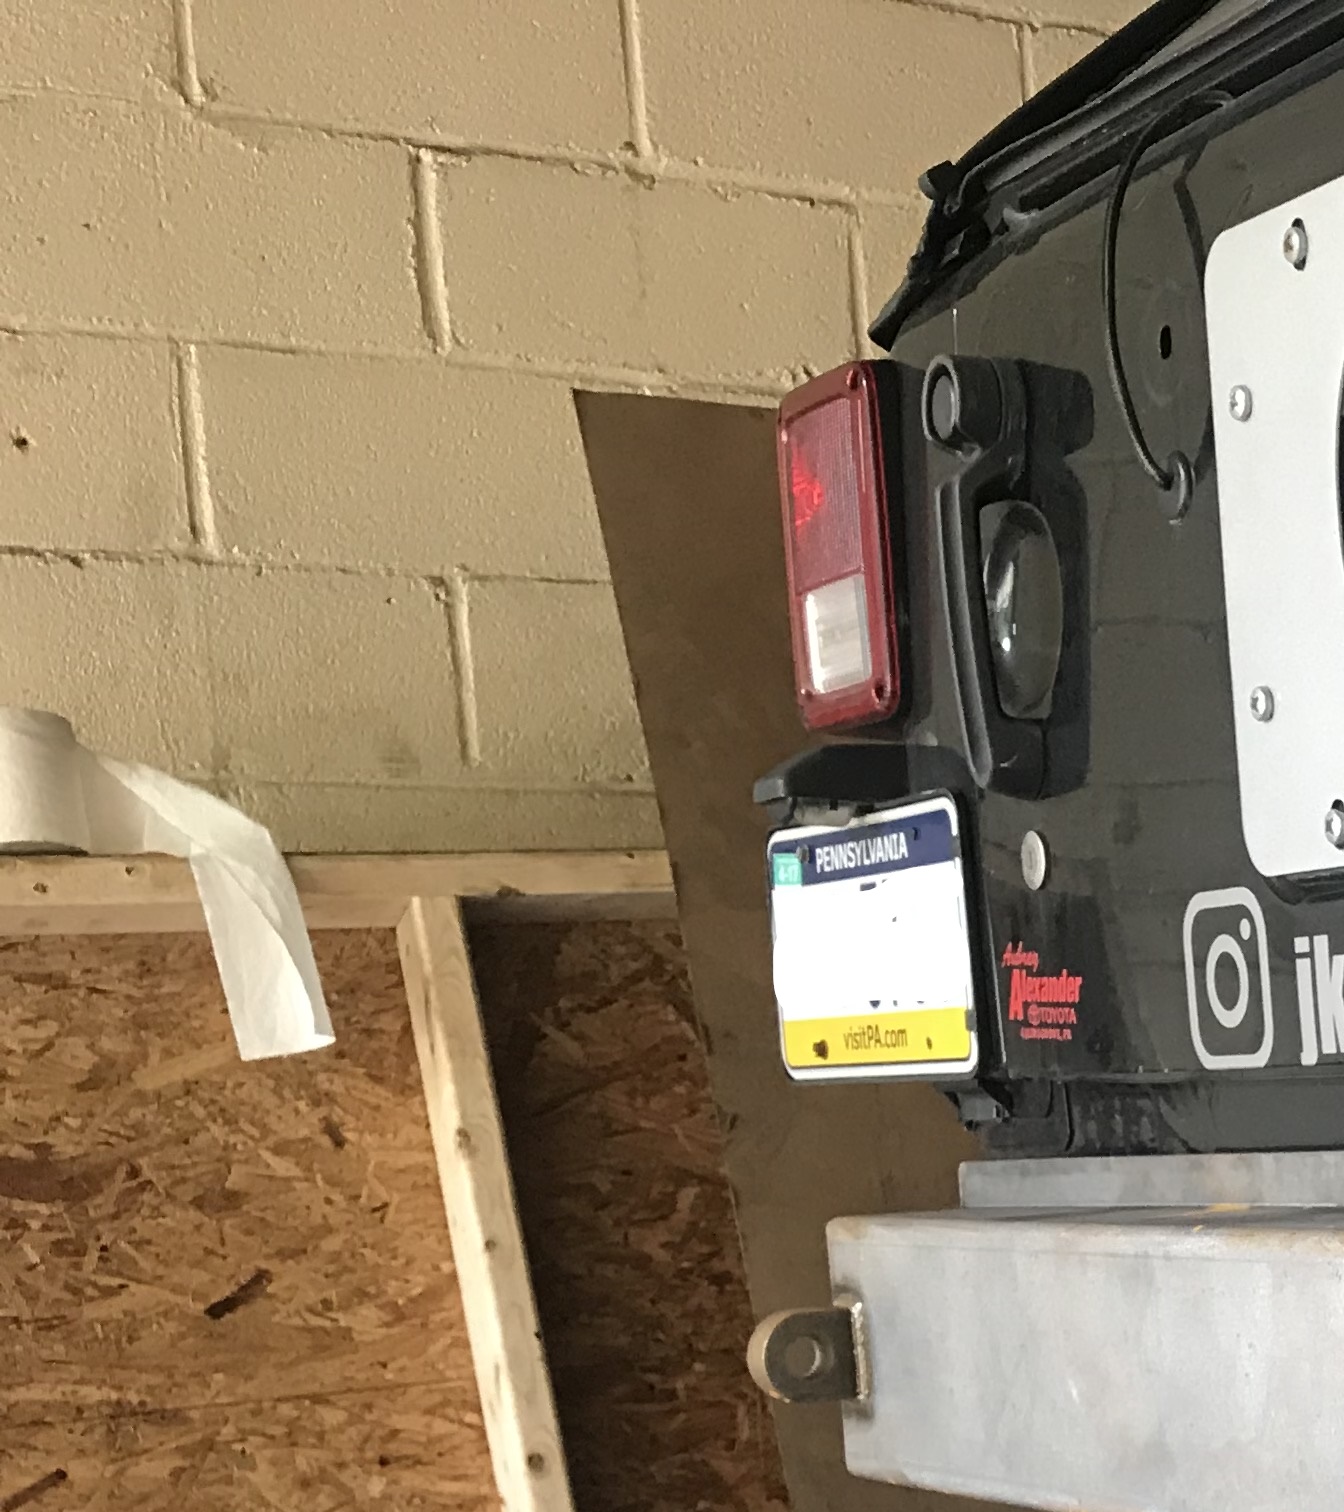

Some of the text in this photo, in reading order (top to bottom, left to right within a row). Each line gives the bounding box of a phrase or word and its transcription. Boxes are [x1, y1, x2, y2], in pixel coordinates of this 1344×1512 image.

[814, 831, 909, 874] PENNSYLVANIA
[1009, 969, 1082, 1021] Alexander
[1039, 1006, 1077, 1024] TOYOTA
[843, 1024, 908, 1051] visitPA.com
